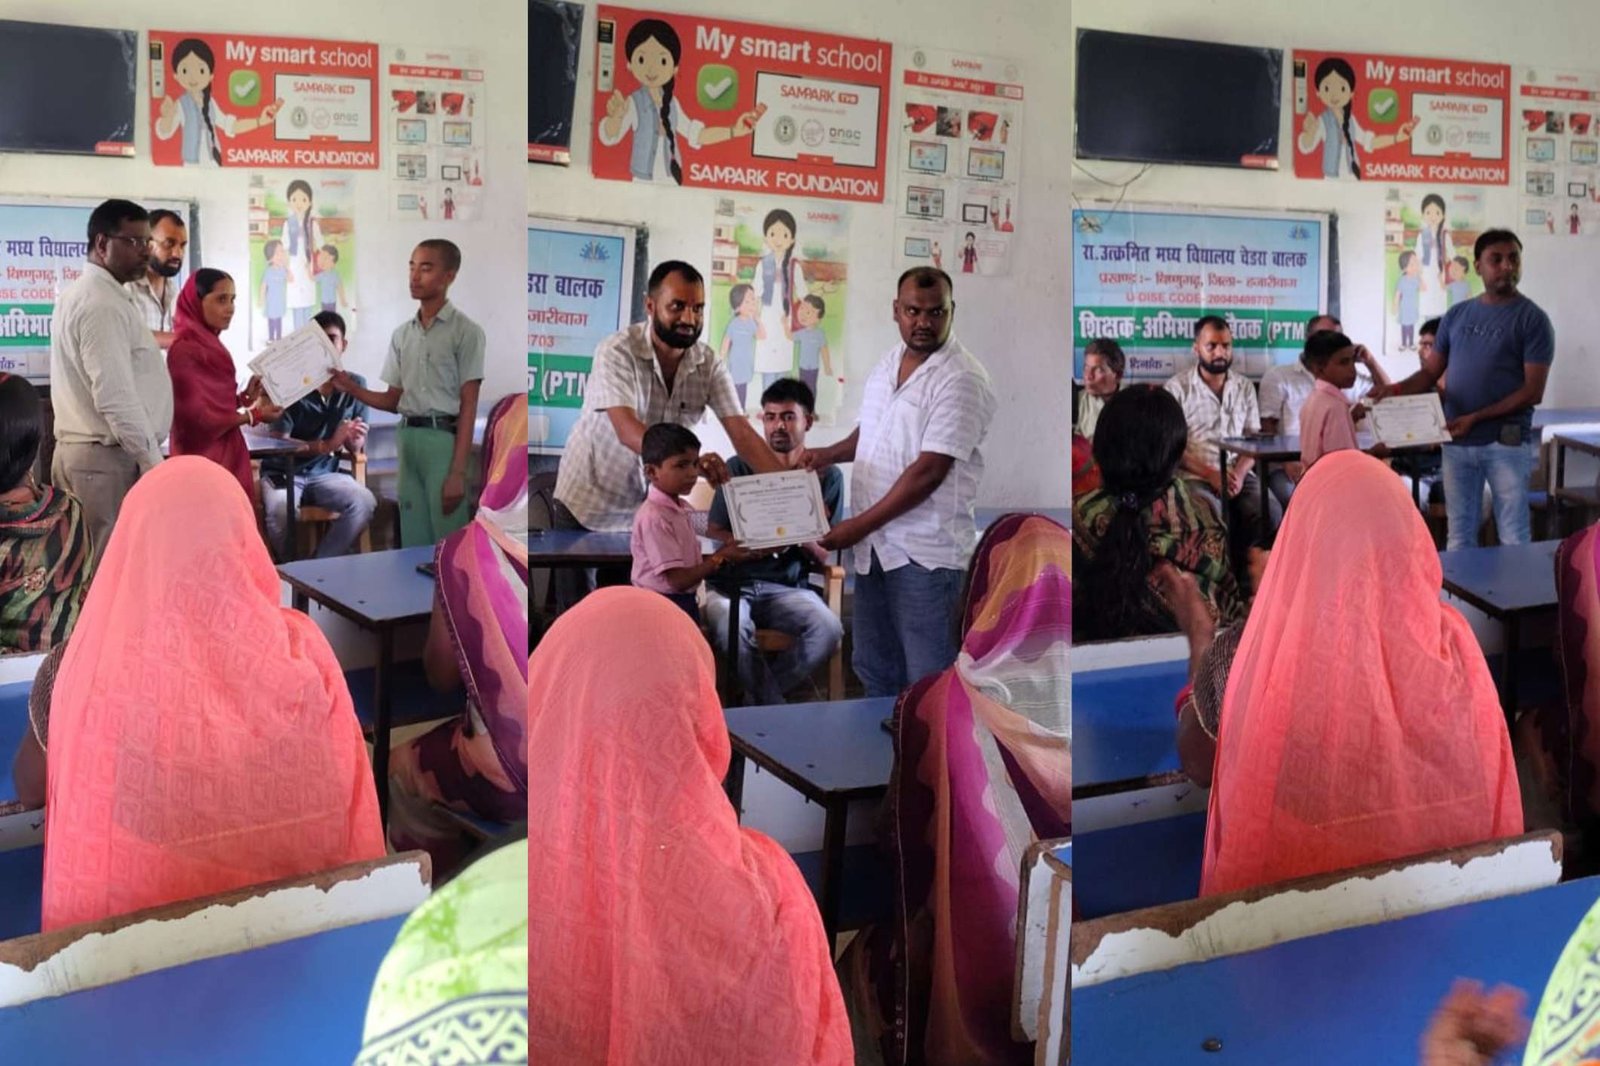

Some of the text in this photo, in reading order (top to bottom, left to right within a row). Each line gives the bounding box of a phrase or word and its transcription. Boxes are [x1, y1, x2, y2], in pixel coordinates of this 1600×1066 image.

[225, 40, 371, 68] My smart school
[696, 25, 882, 73] My smart school
[1365, 60, 1504, 88] My smart school
[781, 84, 834, 102] SAMPARK
[227, 148, 375, 165] SAMPARK FOUNDATION
[690, 163, 878, 197] SAMPARK FOUNDATION
[1365, 163, 1506, 181] SAMPARK FOUNDATION
[1155, 246, 1182, 263] मध्य
[1187, 243, 1235, 265] विद्यालय
[555, 275, 605, 299] बालक
